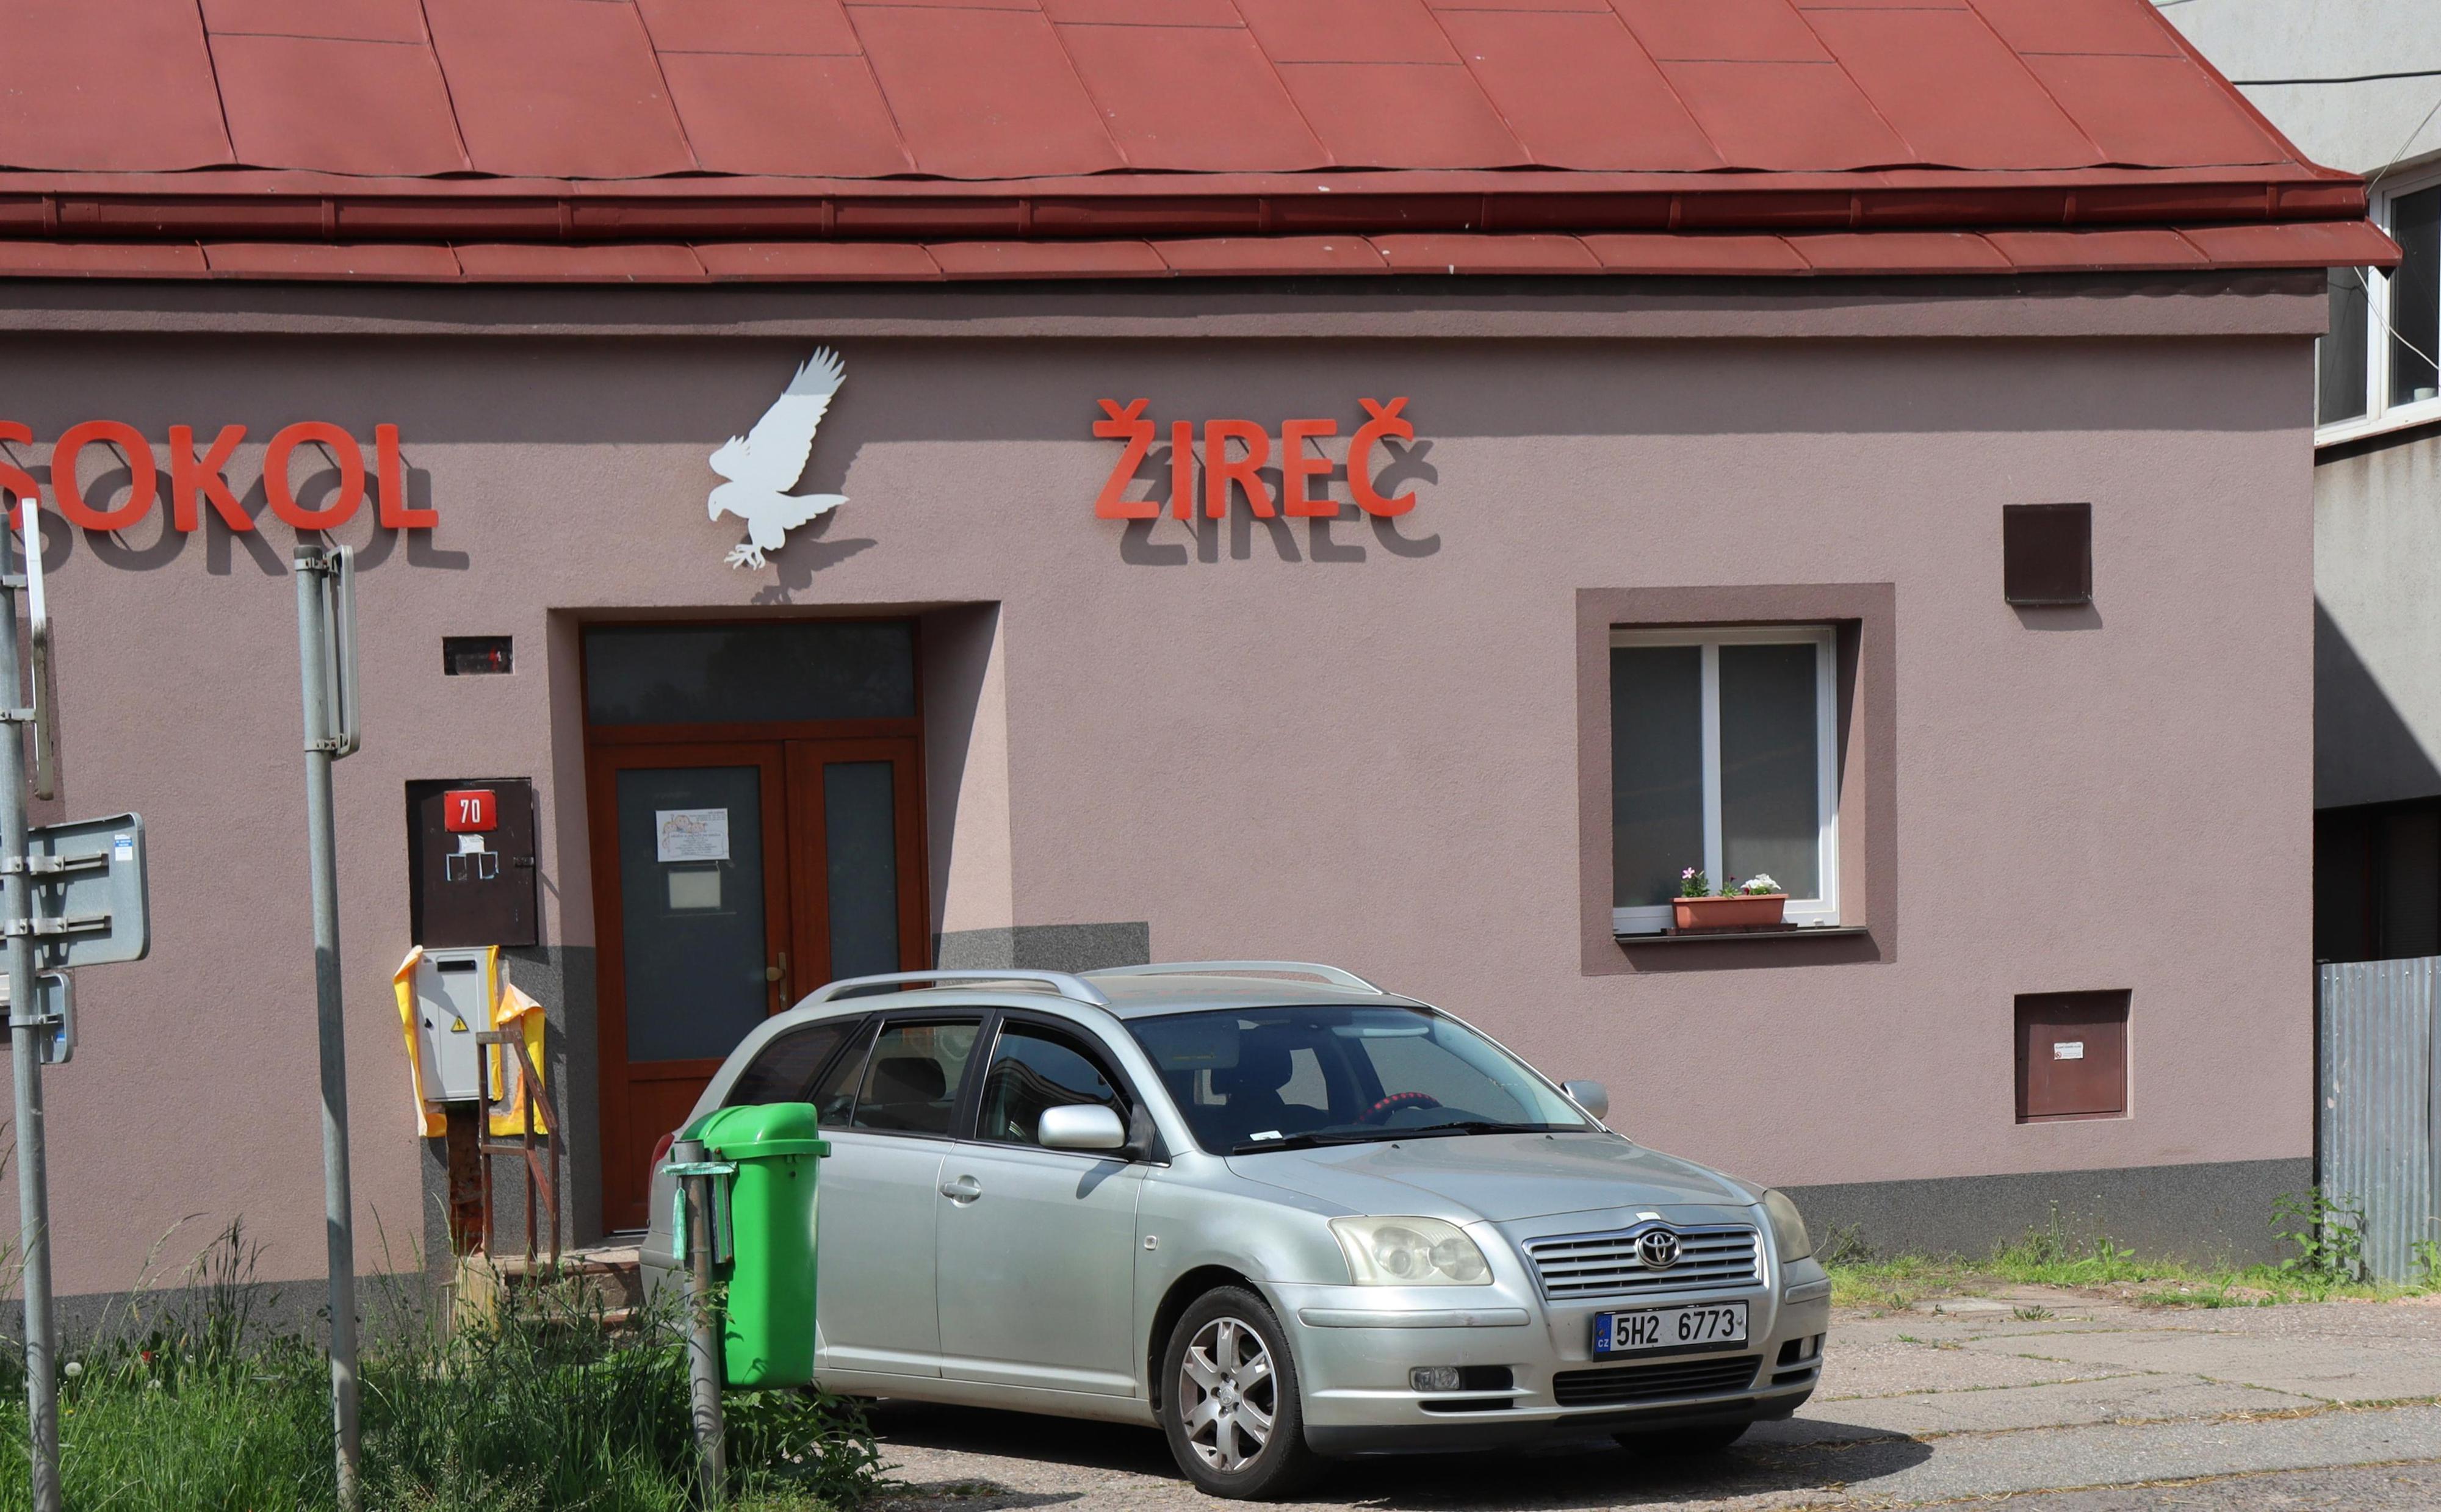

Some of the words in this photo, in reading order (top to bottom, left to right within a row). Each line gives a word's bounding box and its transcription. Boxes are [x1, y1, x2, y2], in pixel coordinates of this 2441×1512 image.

[1092, 397, 1417, 521] ŽIREČ
[460, 799, 480, 824] 70
[1617, 1315, 1659, 1345] 5H2
[1678, 1309, 1734, 1341] 6773
[1598, 1339, 1609, 1348] CZ
